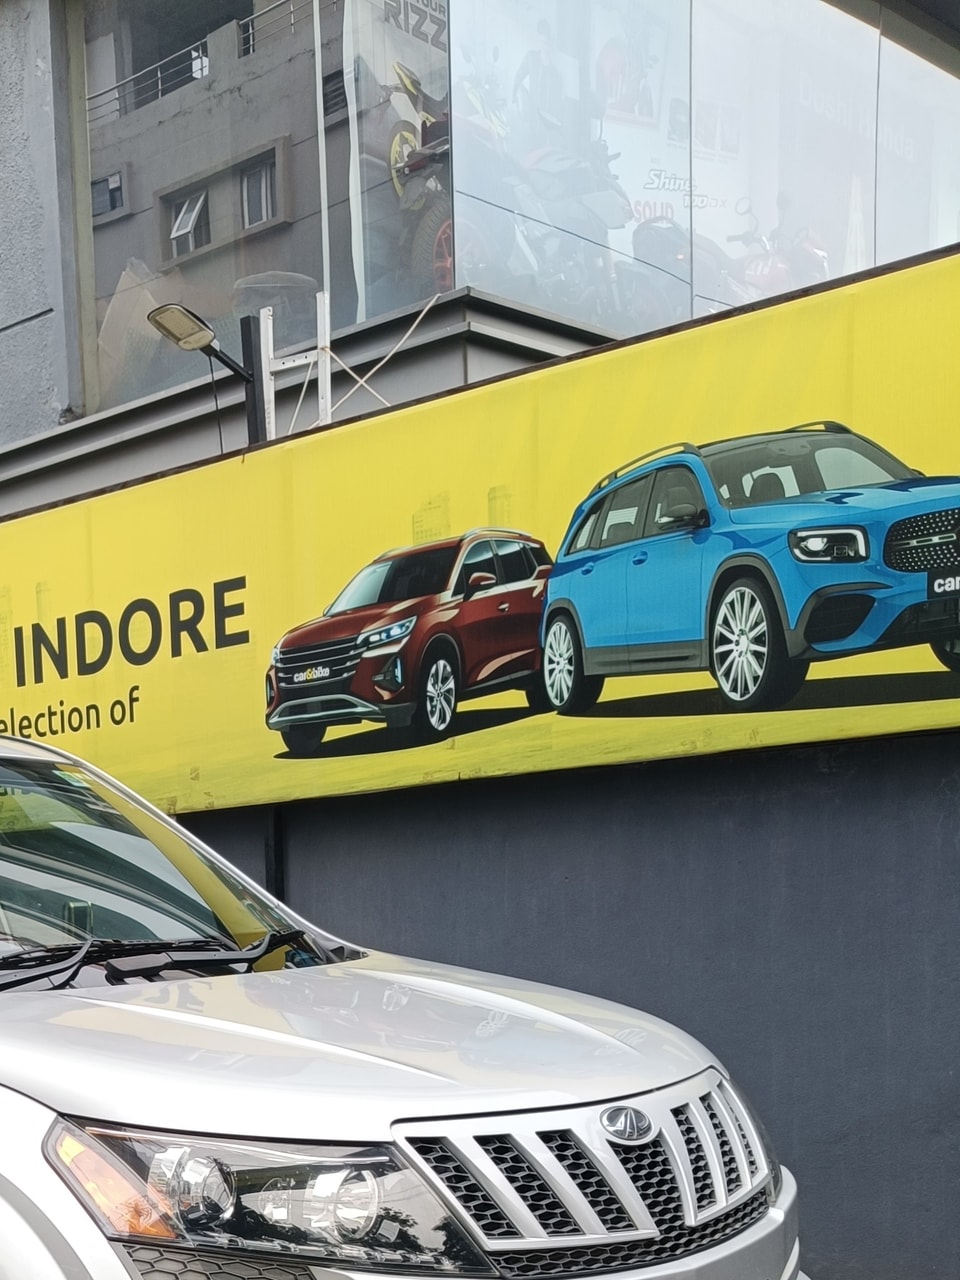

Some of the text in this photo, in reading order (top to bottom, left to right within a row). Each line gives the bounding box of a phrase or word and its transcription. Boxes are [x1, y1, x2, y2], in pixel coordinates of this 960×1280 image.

[416, 0, 447, 18] OUR
[384, 0, 448, 54] RIZZ
[643, 168, 698, 192] Shine
[14, 576, 250, 687] INDORE
[293, 666, 330, 682] car&bike
[110, 685, 140, 725] of
